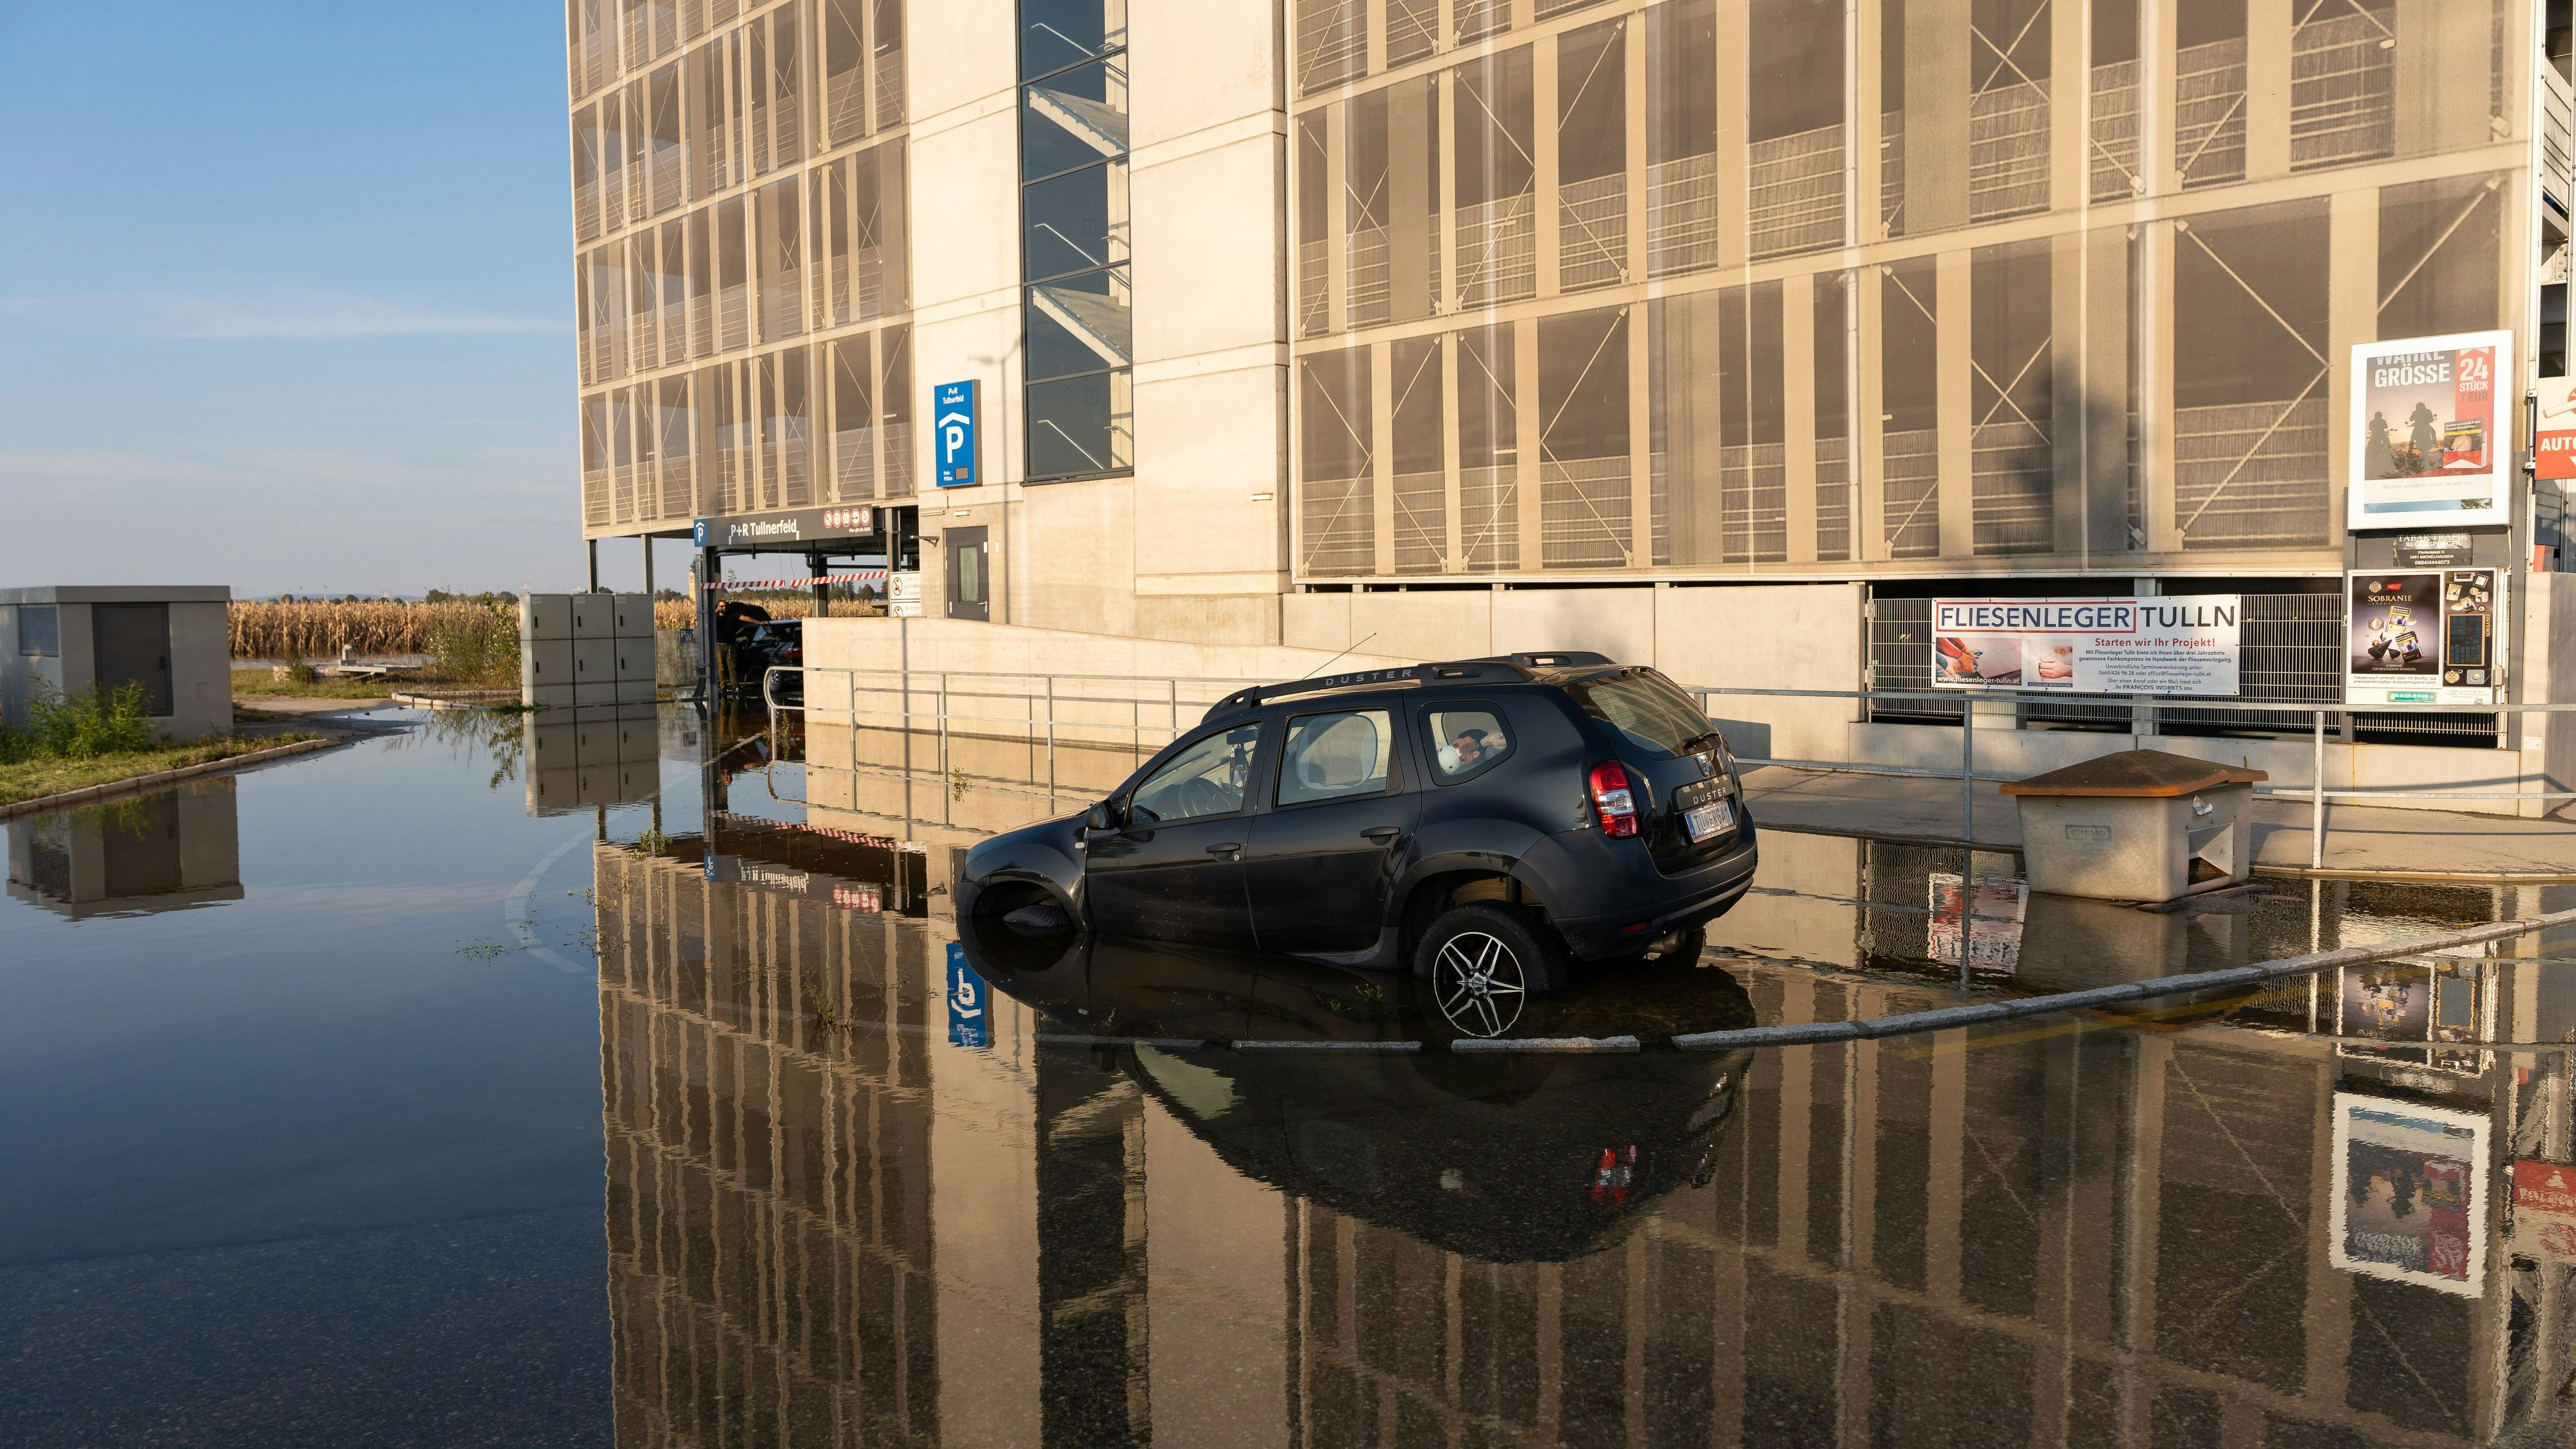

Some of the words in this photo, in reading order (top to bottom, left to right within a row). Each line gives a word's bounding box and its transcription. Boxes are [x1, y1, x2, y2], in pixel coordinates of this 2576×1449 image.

[2375, 363, 2450, 388] GRÖSSE
[2459, 357, 2488, 381] 24
[948, 387, 958, 395] P+R
[2459, 380, 2488, 392] STÜCK
[943, 394, 964, 404] Tullnerfeld
[2460, 393, 2465, 402] 7
[2468, 392, 2488, 402] EUR
[946, 426, 964, 464] P
[697, 527, 703, 542] P
[730, 523, 748, 537] P+R
[750, 518, 797, 536] Tullnerfeld
[1941, 607, 2130, 627] FLIESENLEGER
[2139, 605, 2235, 627] TULLN
[2095, 638, 2131, 647] Starten
[2135, 638, 2151, 647] wir
[2155, 638, 2169, 647] Ihr
[2173, 638, 2215, 649] Projekt!
[1325, 670, 1412, 686] DUSTER
[1937, 676, 2020, 685] www.fliesenleger-tulln.at
[1692, 787, 1727, 805] DUSTER
